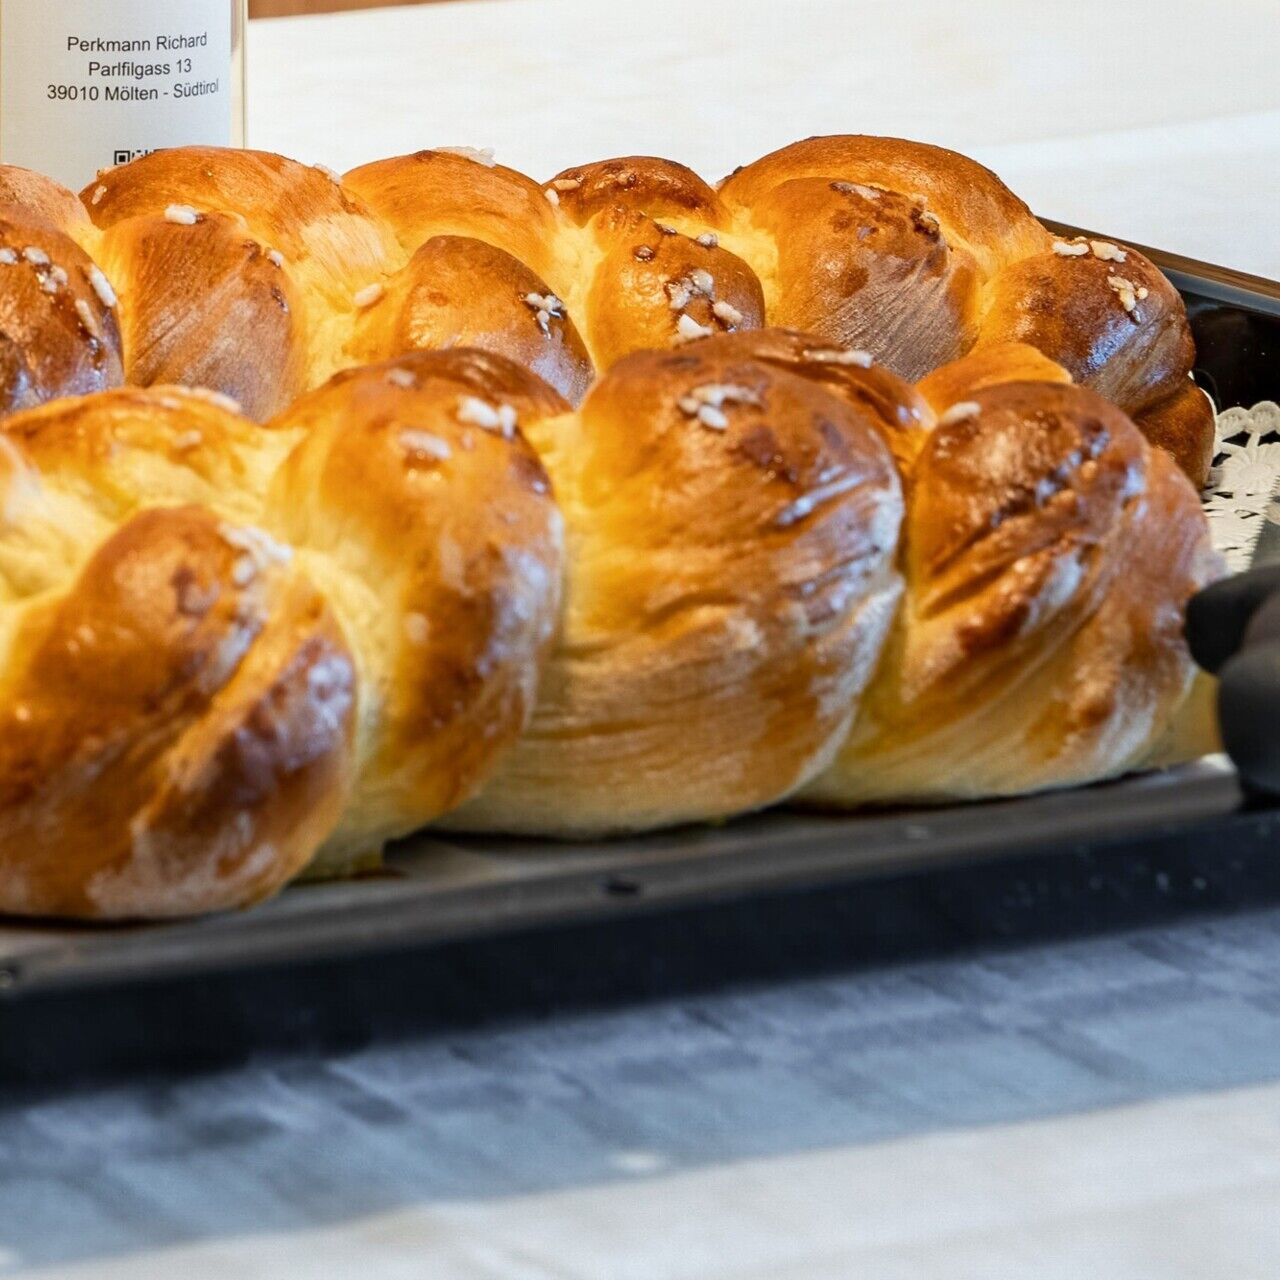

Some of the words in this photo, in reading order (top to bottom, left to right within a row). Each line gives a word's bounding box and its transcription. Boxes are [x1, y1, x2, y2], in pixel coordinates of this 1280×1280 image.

[67, 36, 151, 52] Perkmann
[156, 32, 208, 51] Richard
[176, 58, 192, 73] 13
[47, 84, 99, 101] 39010
[105, 86, 158, 101] Mölten
[173, 78, 219, 98] Südtirol
